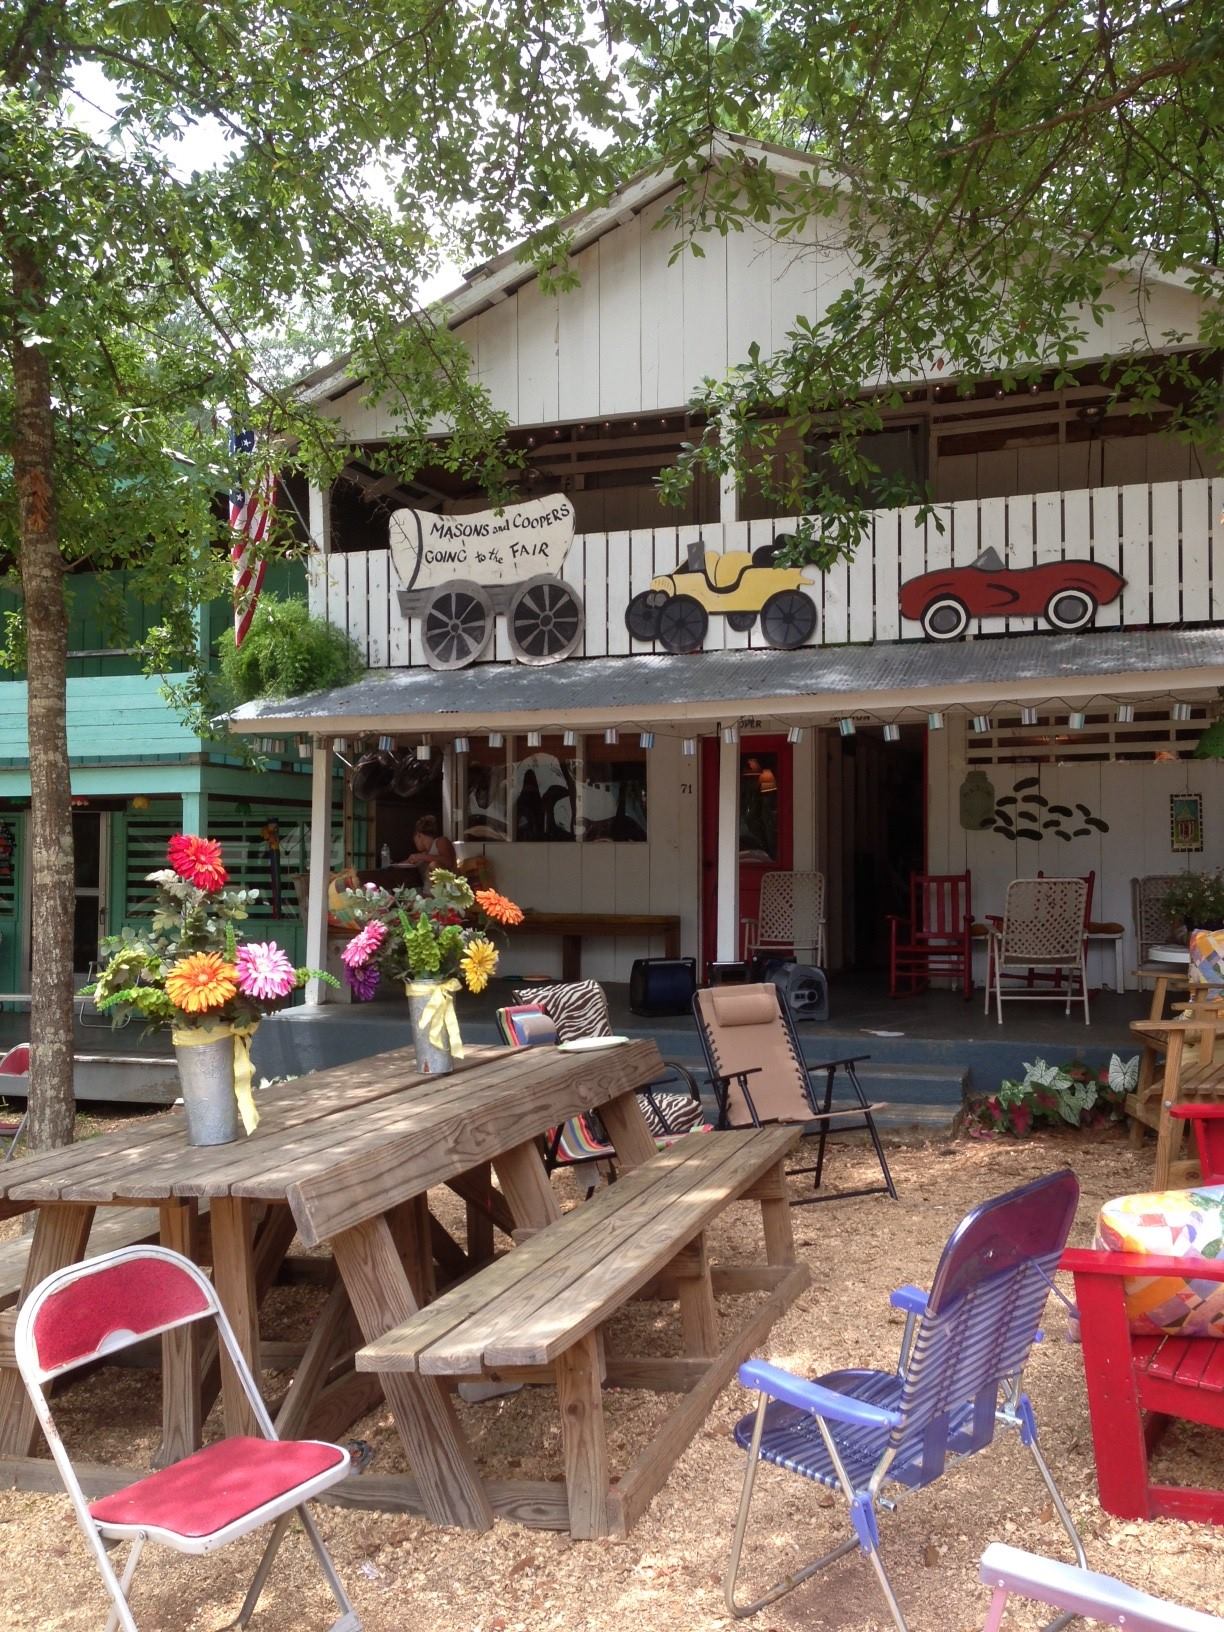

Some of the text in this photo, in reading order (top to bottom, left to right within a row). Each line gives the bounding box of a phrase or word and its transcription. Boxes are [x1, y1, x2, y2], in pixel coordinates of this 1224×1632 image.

[430, 503, 570, 540] MASONS and COOPERS
[424, 541, 549, 564] GOING to the FAIR
[680, 783, 693, 794] 71
